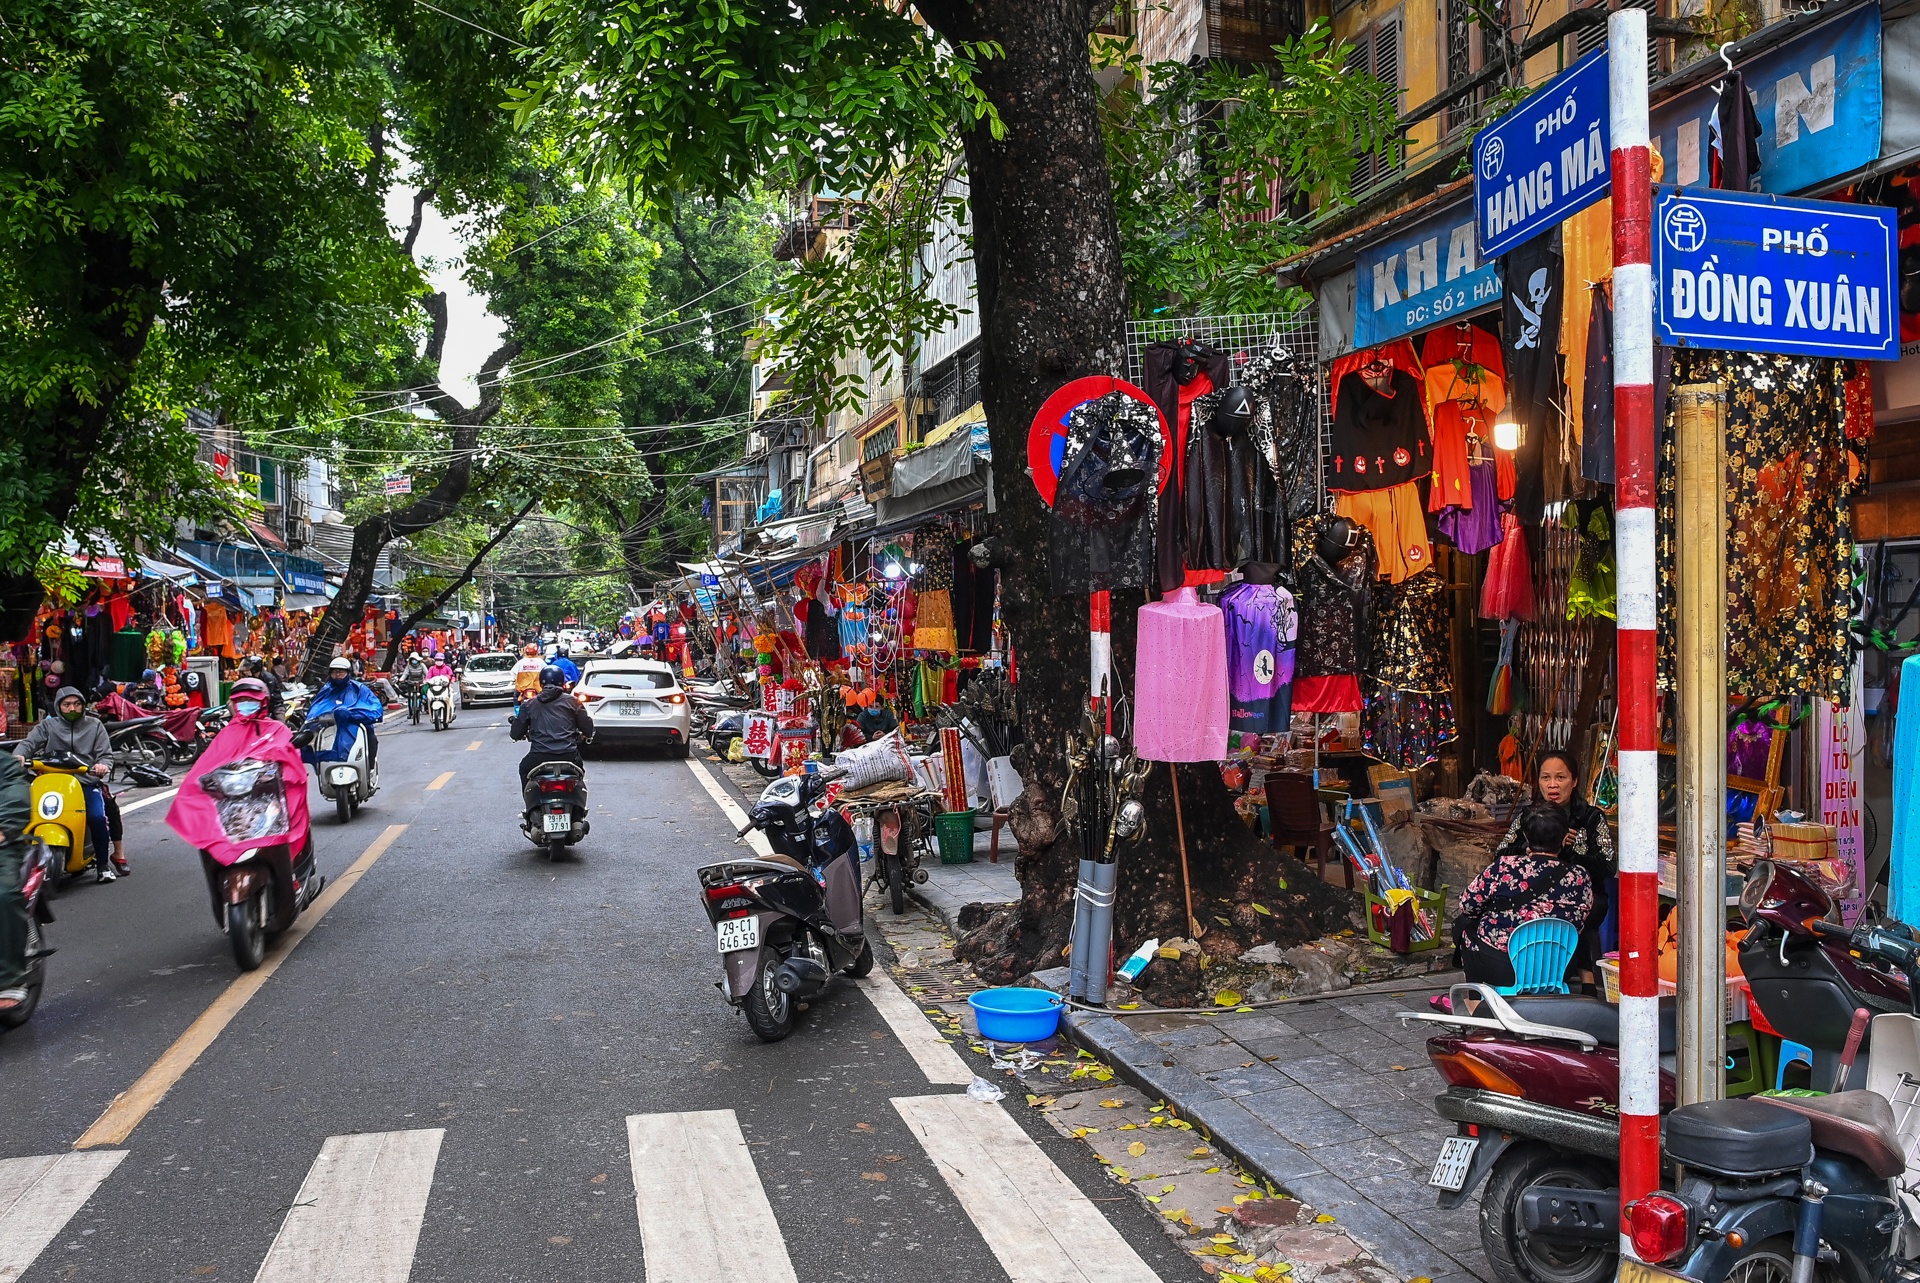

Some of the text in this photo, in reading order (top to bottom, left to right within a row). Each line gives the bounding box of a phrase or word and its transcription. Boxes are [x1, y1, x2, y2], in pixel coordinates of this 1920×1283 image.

[1535, 86, 1578, 145] PHỐ
[1487, 118, 1606, 240] HÀNG MÃ
[1762, 223, 1829, 257] PHỐ
[1406, 306, 1429, 326] ĐC:
[1433, 288, 1454, 315] SỐ
[1456, 290, 1465, 307] 2
[1671, 254, 1881, 335] ĐỒNG XUÂN
[1232, 708, 1265, 718] Halloween
[1833, 749, 1849, 770] TÔ
[1825, 778, 1857, 803] ĐIỆN
[723, 919, 751, 936] 29-C1
[719, 932, 756, 951] 646.59
[1442, 1140, 1473, 1162] 29-C1
[1432, 1162, 1465, 1187] 291.19
